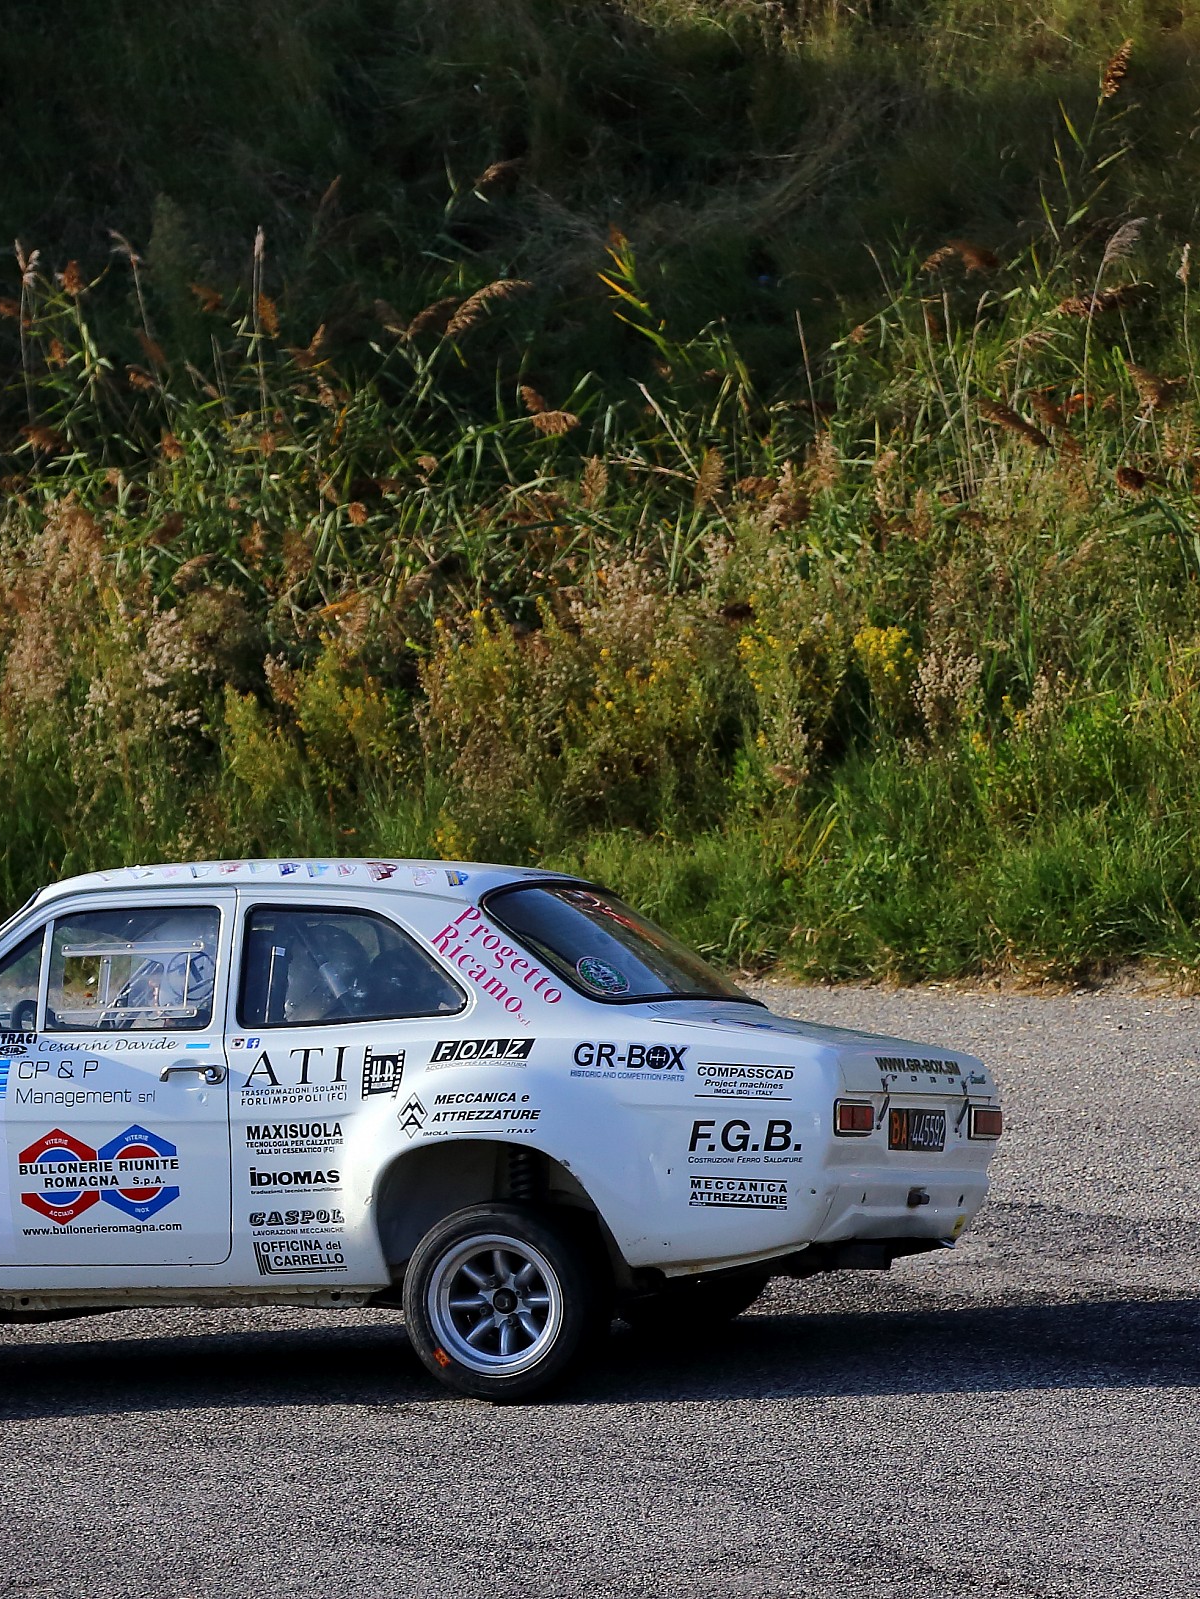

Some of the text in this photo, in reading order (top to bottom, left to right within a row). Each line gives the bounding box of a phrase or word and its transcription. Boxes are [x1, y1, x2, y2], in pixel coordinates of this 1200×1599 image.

[453, 905, 562, 1004] Progetto
[431, 924, 523, 1013] Ricamo
[38, 1037, 179, 1052] Cesarini Davide
[17, 1060, 99, 1080] CP & P
[602, 1071, 616, 1079] AND
[617, 1072, 661, 1081] COMPETITION
[662, 1074, 685, 1082] PARTS
[697, 1066, 794, 1080] COMPASSCAD
[241, 1085, 348, 1097] TRASFORMAZIONI ISOLANTI
[704, 1078, 784, 1090] Project machines
[15, 1088, 156, 1108] Management srl
[241, 1092, 348, 1106] FORLIMPOPOLI (FC)
[434, 1092, 530, 1105] MECCANICA e
[431, 1109, 541, 1123] ATTREZZATURE
[246, 1122, 343, 1140] MAXISUOLA
[891, 1111, 908, 1145] BA
[245, 1138, 344, 1148] TECNOLOGIA PER CALZATURE
[688, 1119, 802, 1153] F.G.B.
[255, 1147, 273, 1155] SALA
[18, 1158, 180, 1176] BULLONERIE RIUNITE
[44, 1175, 166, 1188] ROMAGNA S.p.A.
[690, 1179, 788, 1193] MECCANICA
[689, 1191, 788, 1205] ATTREZZATURE
[22, 1222, 183, 1237] www.bullonerieromagna.com
[252, 1226, 344, 1237] LAVORAZIONI MECCANICHE
[261, 1240, 342, 1253] OFFICINA del
[273, 1252, 345, 1266] CARRELLO
